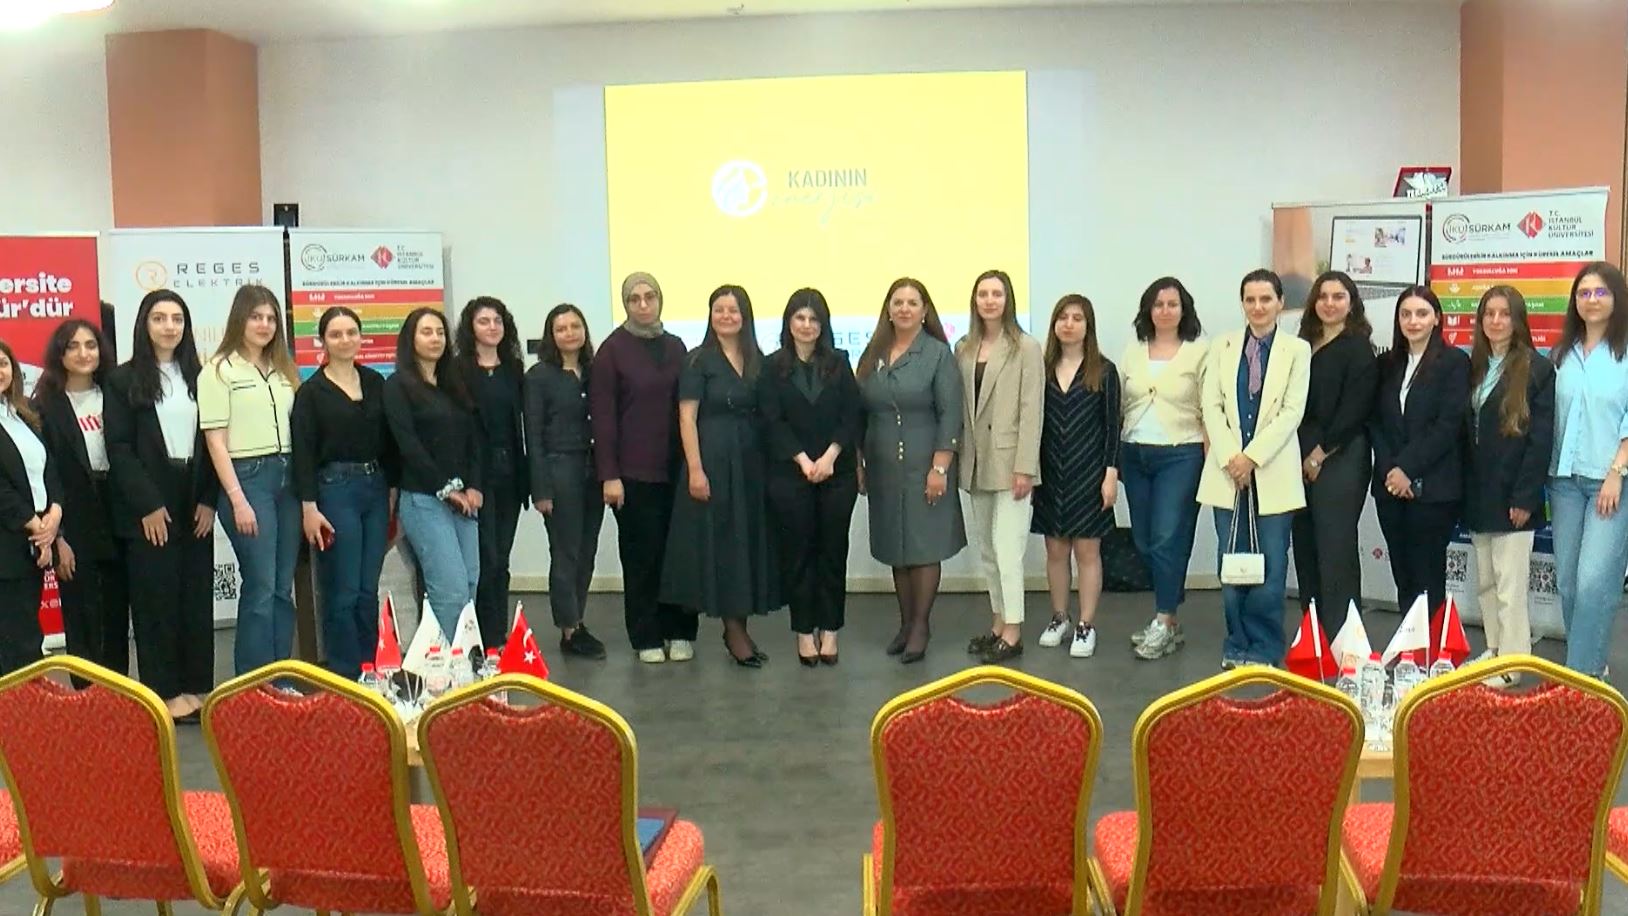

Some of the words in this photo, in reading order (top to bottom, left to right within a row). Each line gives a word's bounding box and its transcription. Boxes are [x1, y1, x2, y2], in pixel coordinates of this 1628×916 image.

[788, 168, 867, 188] KADININ
[1468, 222, 1511, 233] SÜRKAM
[176, 261, 260, 275] REGES
[0, 271, 72, 294] ersite
